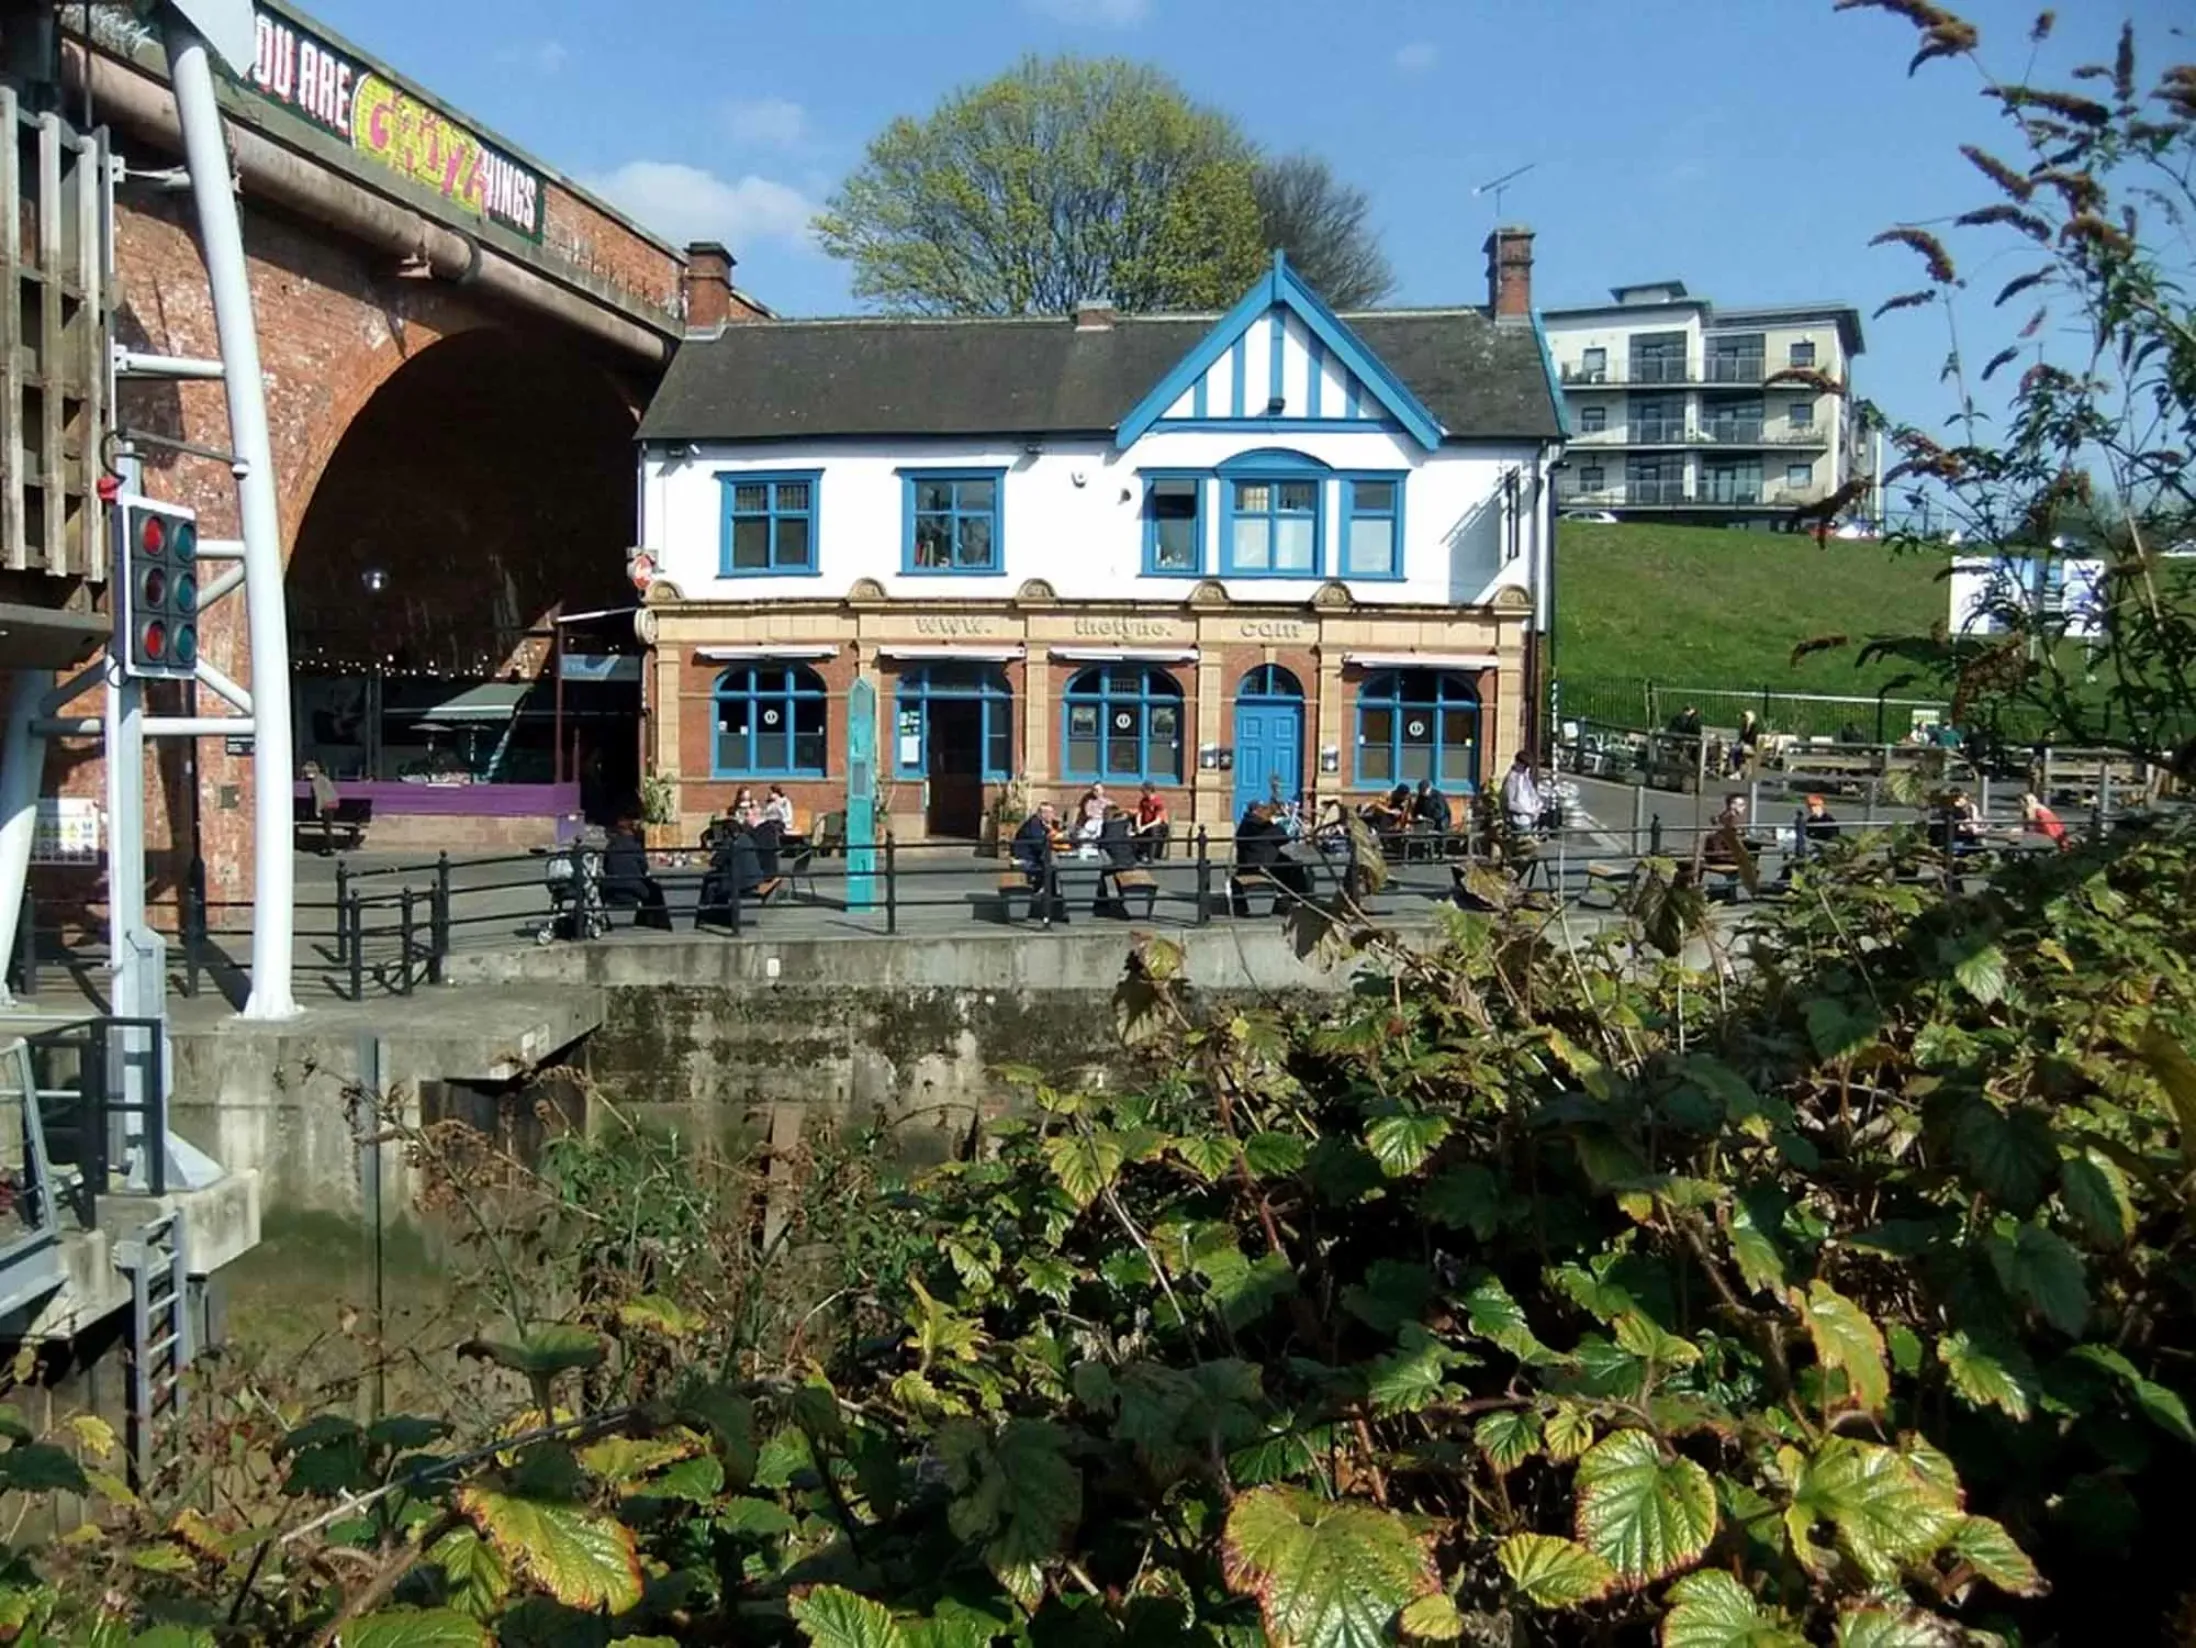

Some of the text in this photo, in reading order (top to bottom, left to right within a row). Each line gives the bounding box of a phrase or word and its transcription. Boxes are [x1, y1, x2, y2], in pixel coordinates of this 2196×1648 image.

[247, 12, 296, 103] OU
[298, 40, 352, 136] ARE
[481, 149, 537, 233] HINGS
[1240, 621, 1301, 639] com
